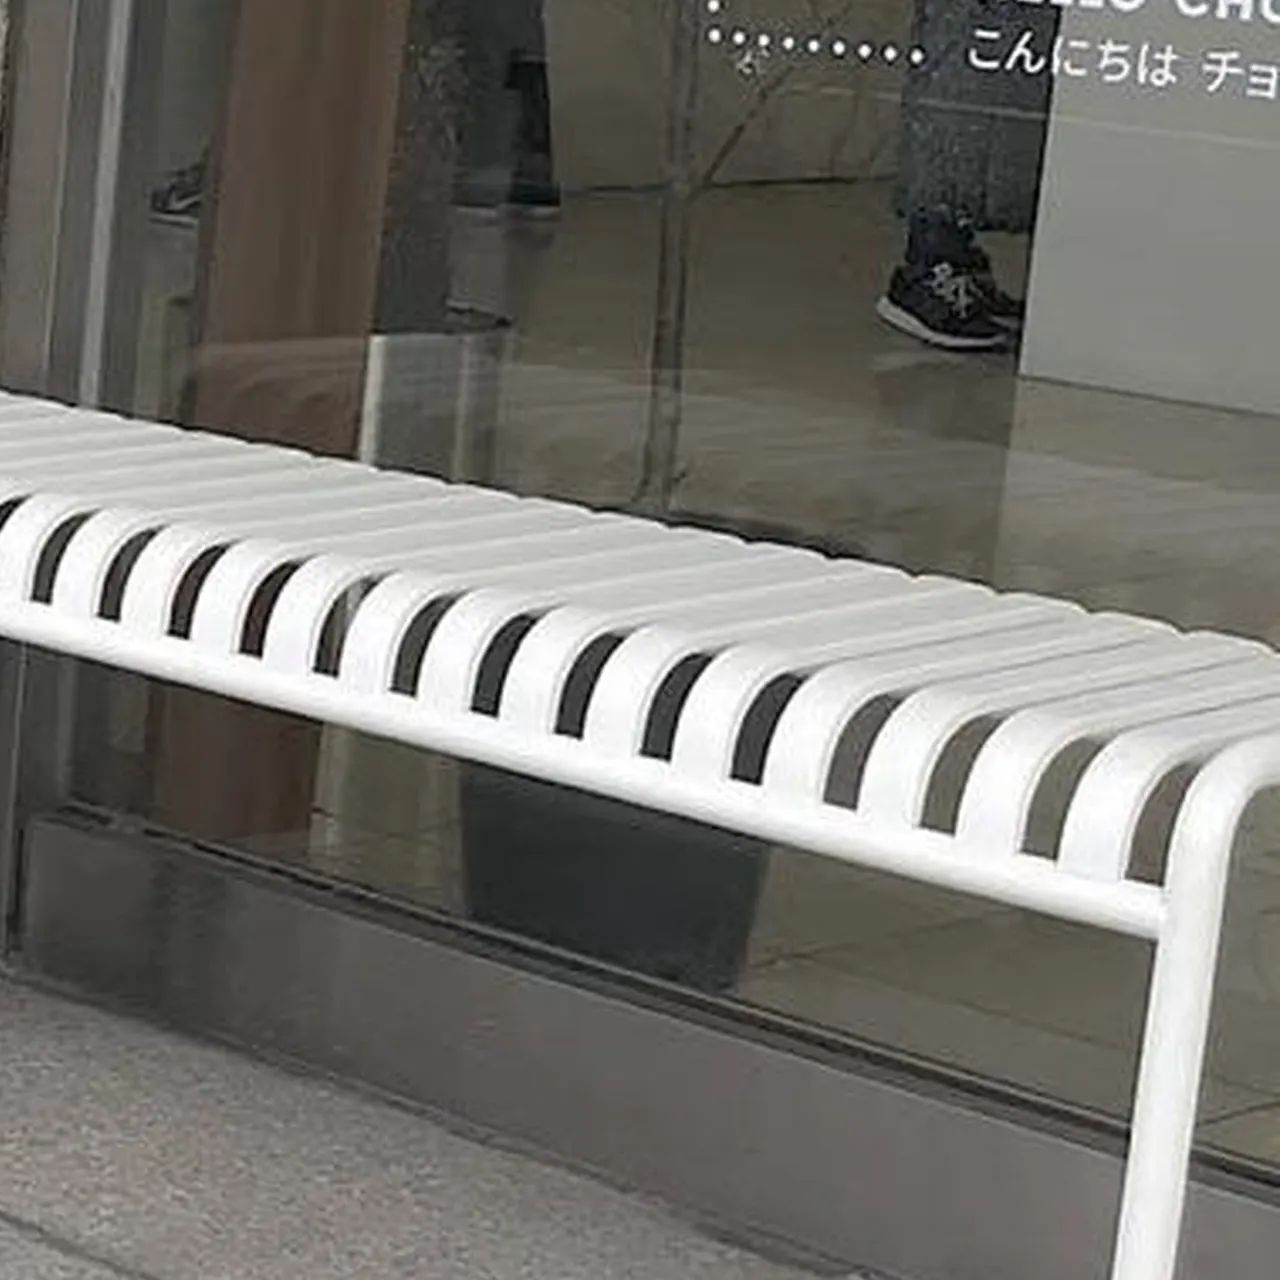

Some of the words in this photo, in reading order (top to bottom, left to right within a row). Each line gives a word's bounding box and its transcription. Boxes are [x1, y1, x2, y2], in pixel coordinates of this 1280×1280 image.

[969, 30, 1178, 86] こんにちは
